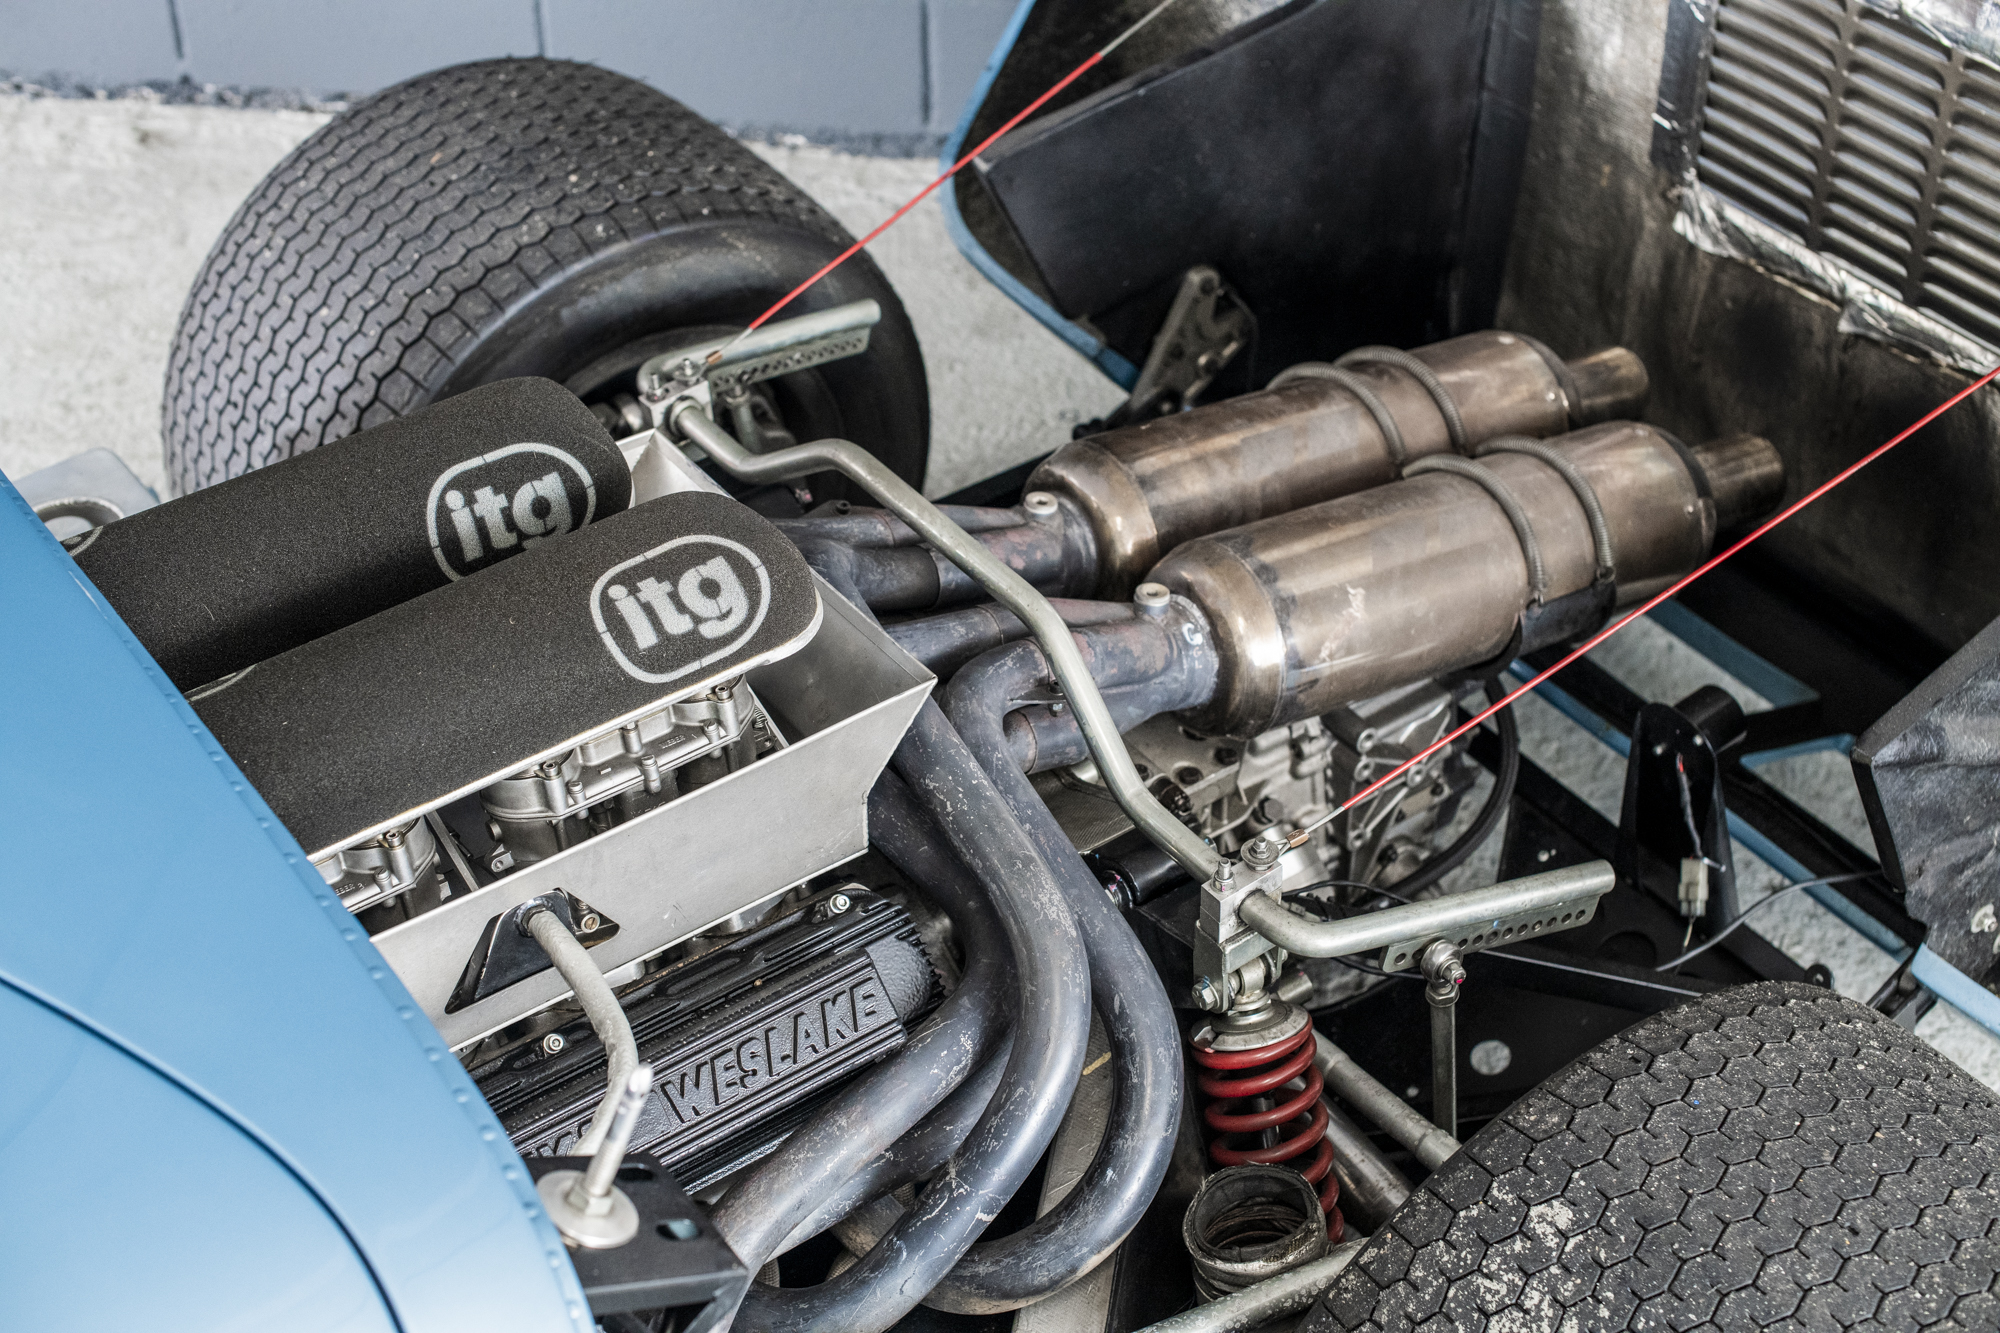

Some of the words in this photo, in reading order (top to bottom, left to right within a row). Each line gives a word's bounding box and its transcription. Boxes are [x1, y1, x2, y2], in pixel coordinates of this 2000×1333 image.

[445, 471, 573, 563] itg
[608, 555, 750, 650] itg
[660, 976, 878, 1124] WESLAKE
